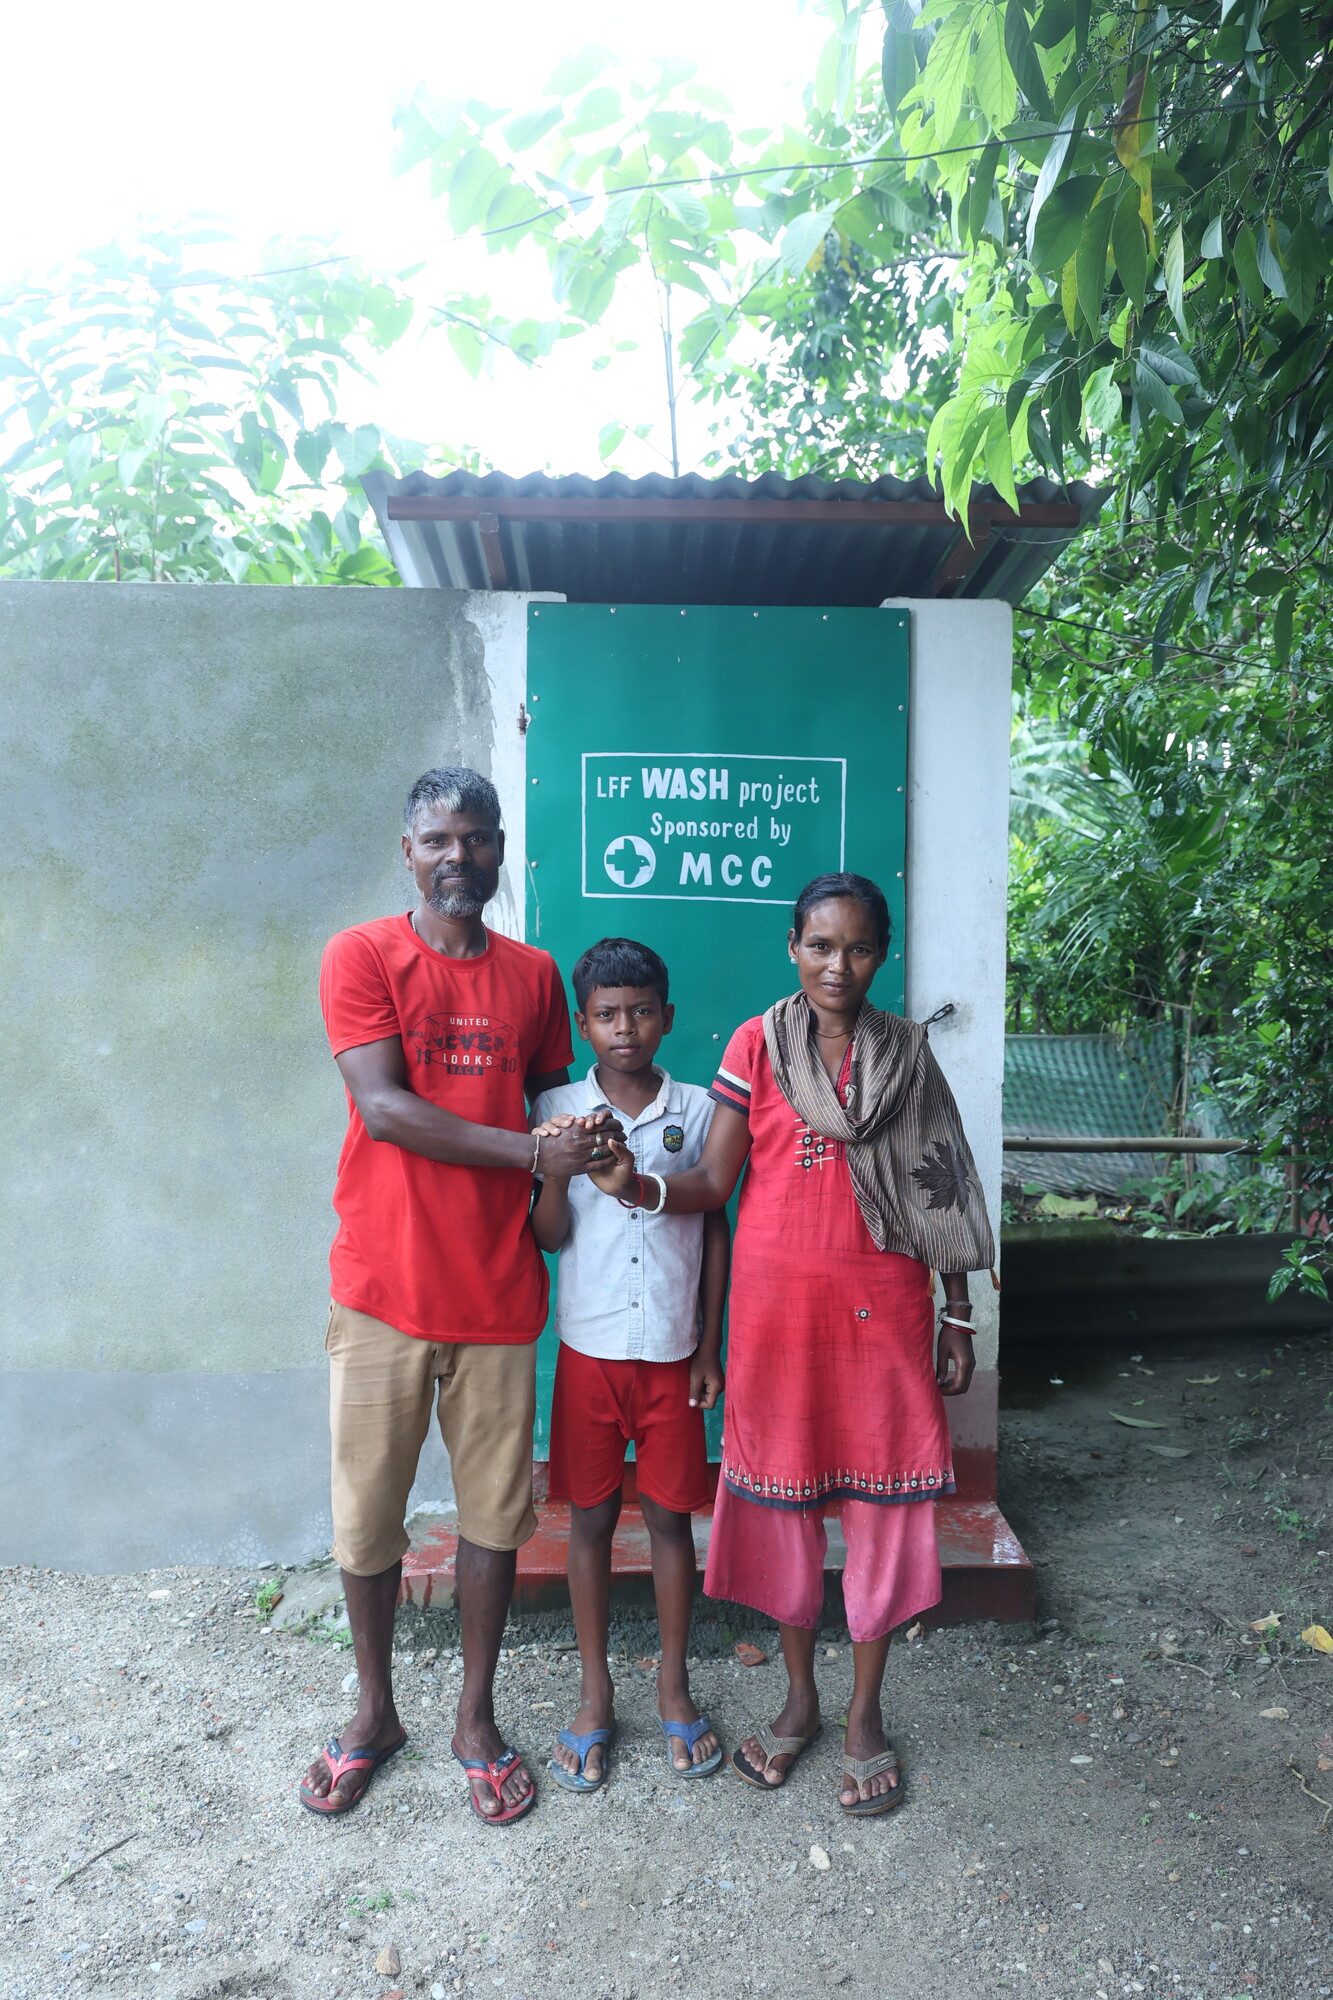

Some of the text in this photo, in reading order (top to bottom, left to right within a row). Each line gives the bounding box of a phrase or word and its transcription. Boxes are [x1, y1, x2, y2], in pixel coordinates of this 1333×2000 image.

[596, 767, 820, 810] LFF WASH project
[650, 812, 792, 847] Sponsored by
[449, 1017, 489, 1026] UNITED
[443, 1053, 493, 1066] LOOKS
[449, 1066, 481, 1075] BACK
